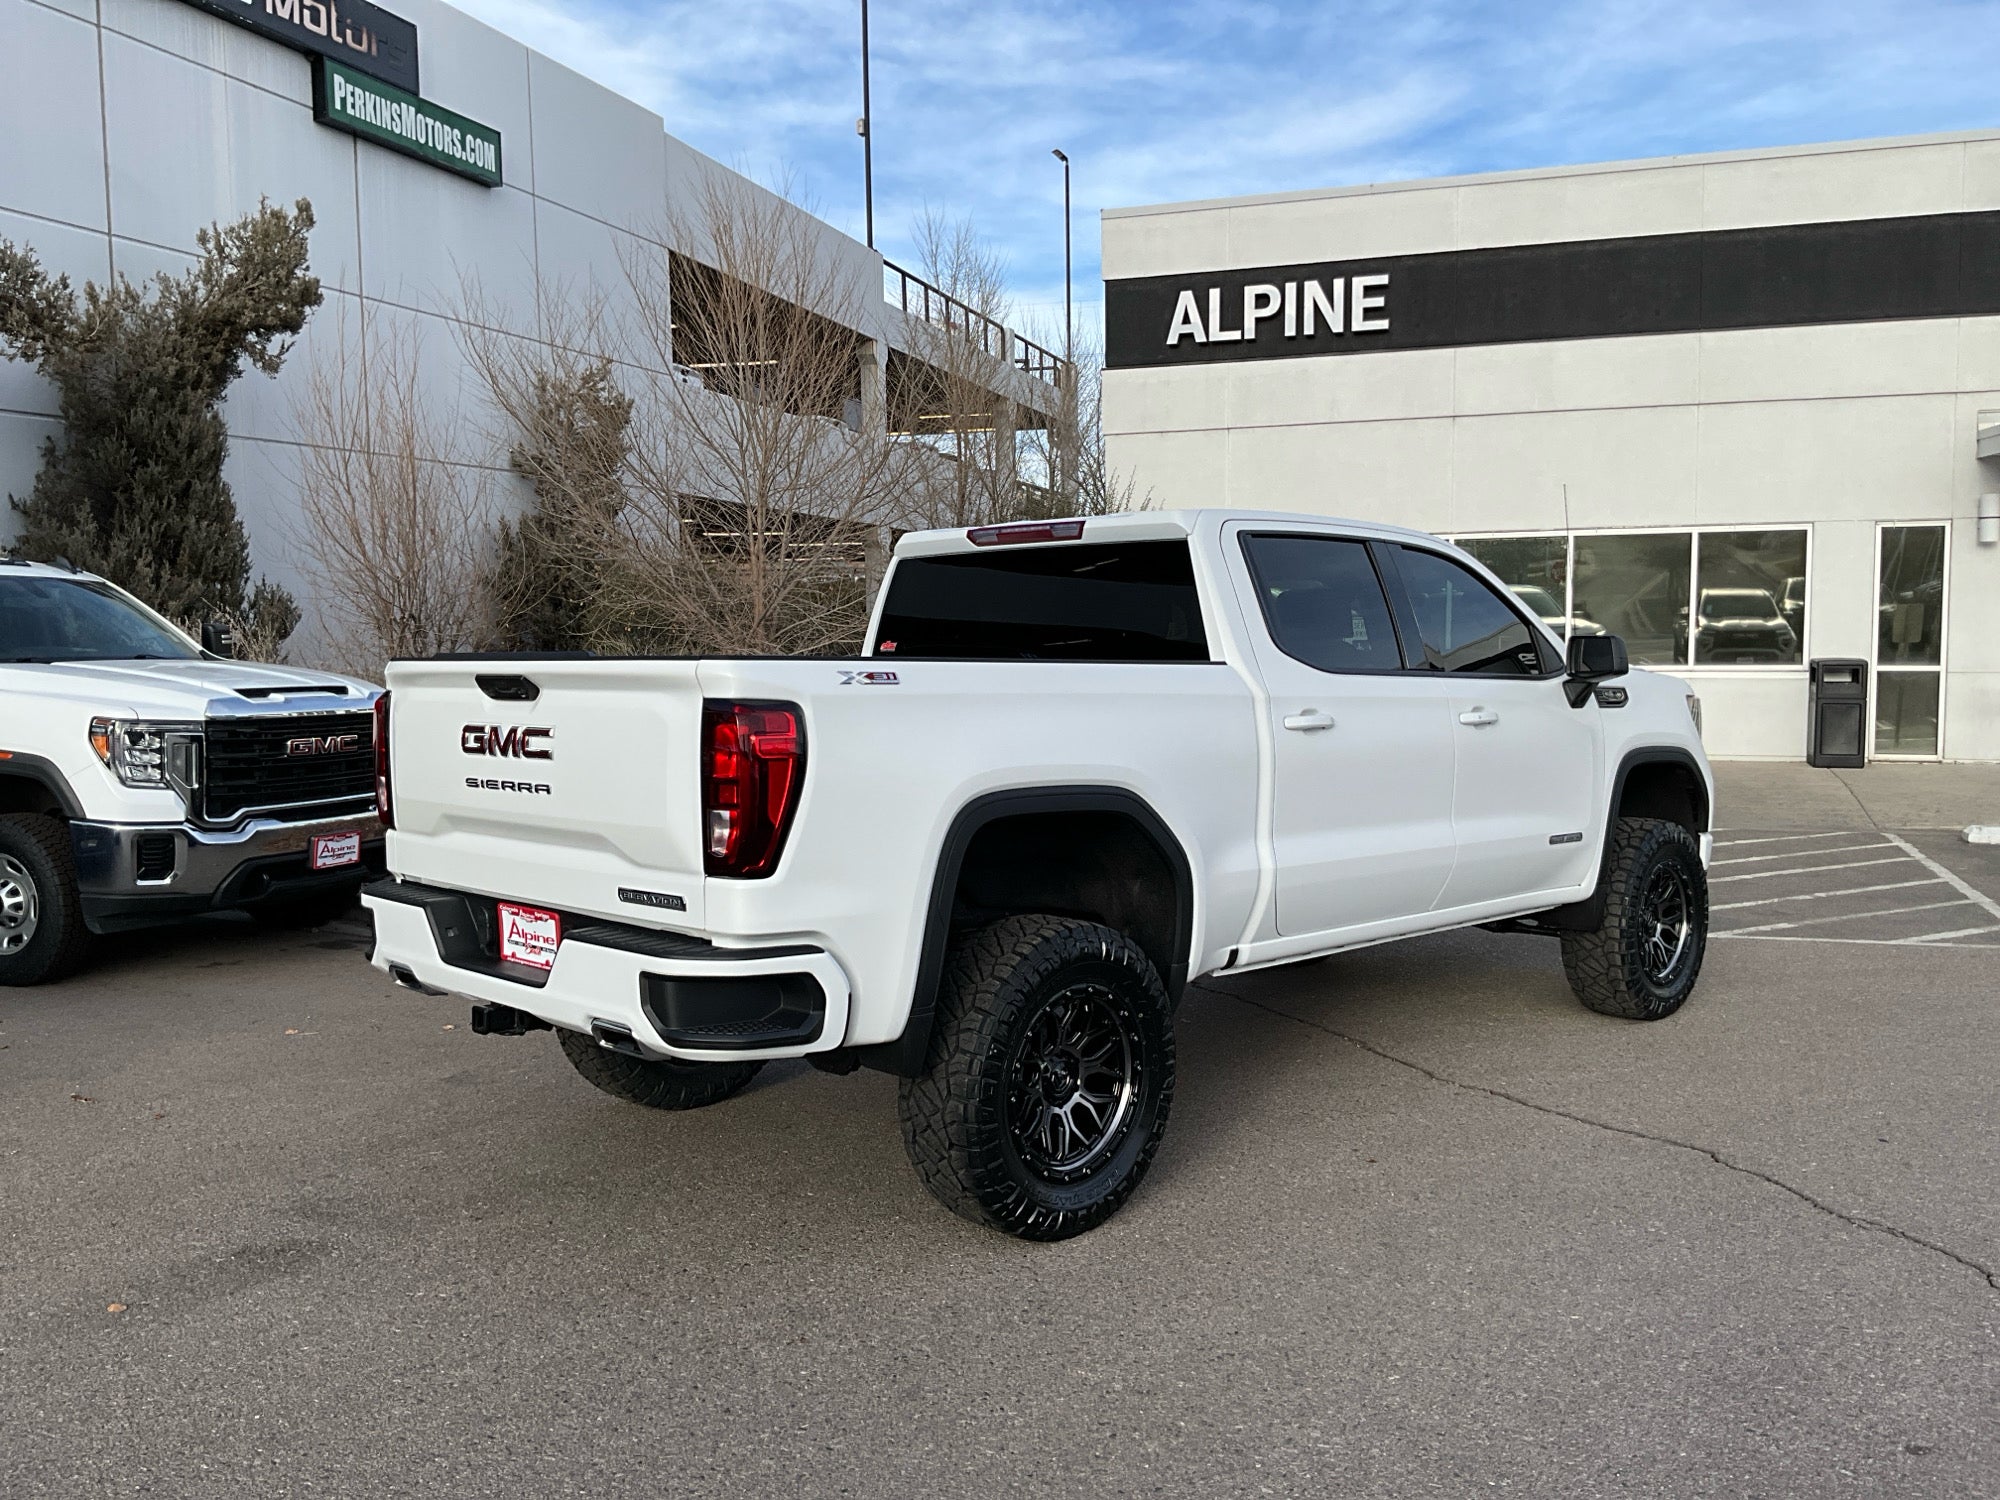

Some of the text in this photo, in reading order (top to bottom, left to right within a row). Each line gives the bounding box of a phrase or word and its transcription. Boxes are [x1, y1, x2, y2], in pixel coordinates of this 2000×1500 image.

[1166, 274, 1390, 345] ALPINE
[286, 735, 358, 756] GMC
[461, 723, 555, 760] GMC
[465, 777, 551, 795] SIERRA
[508, 916, 556, 946] Alpine
